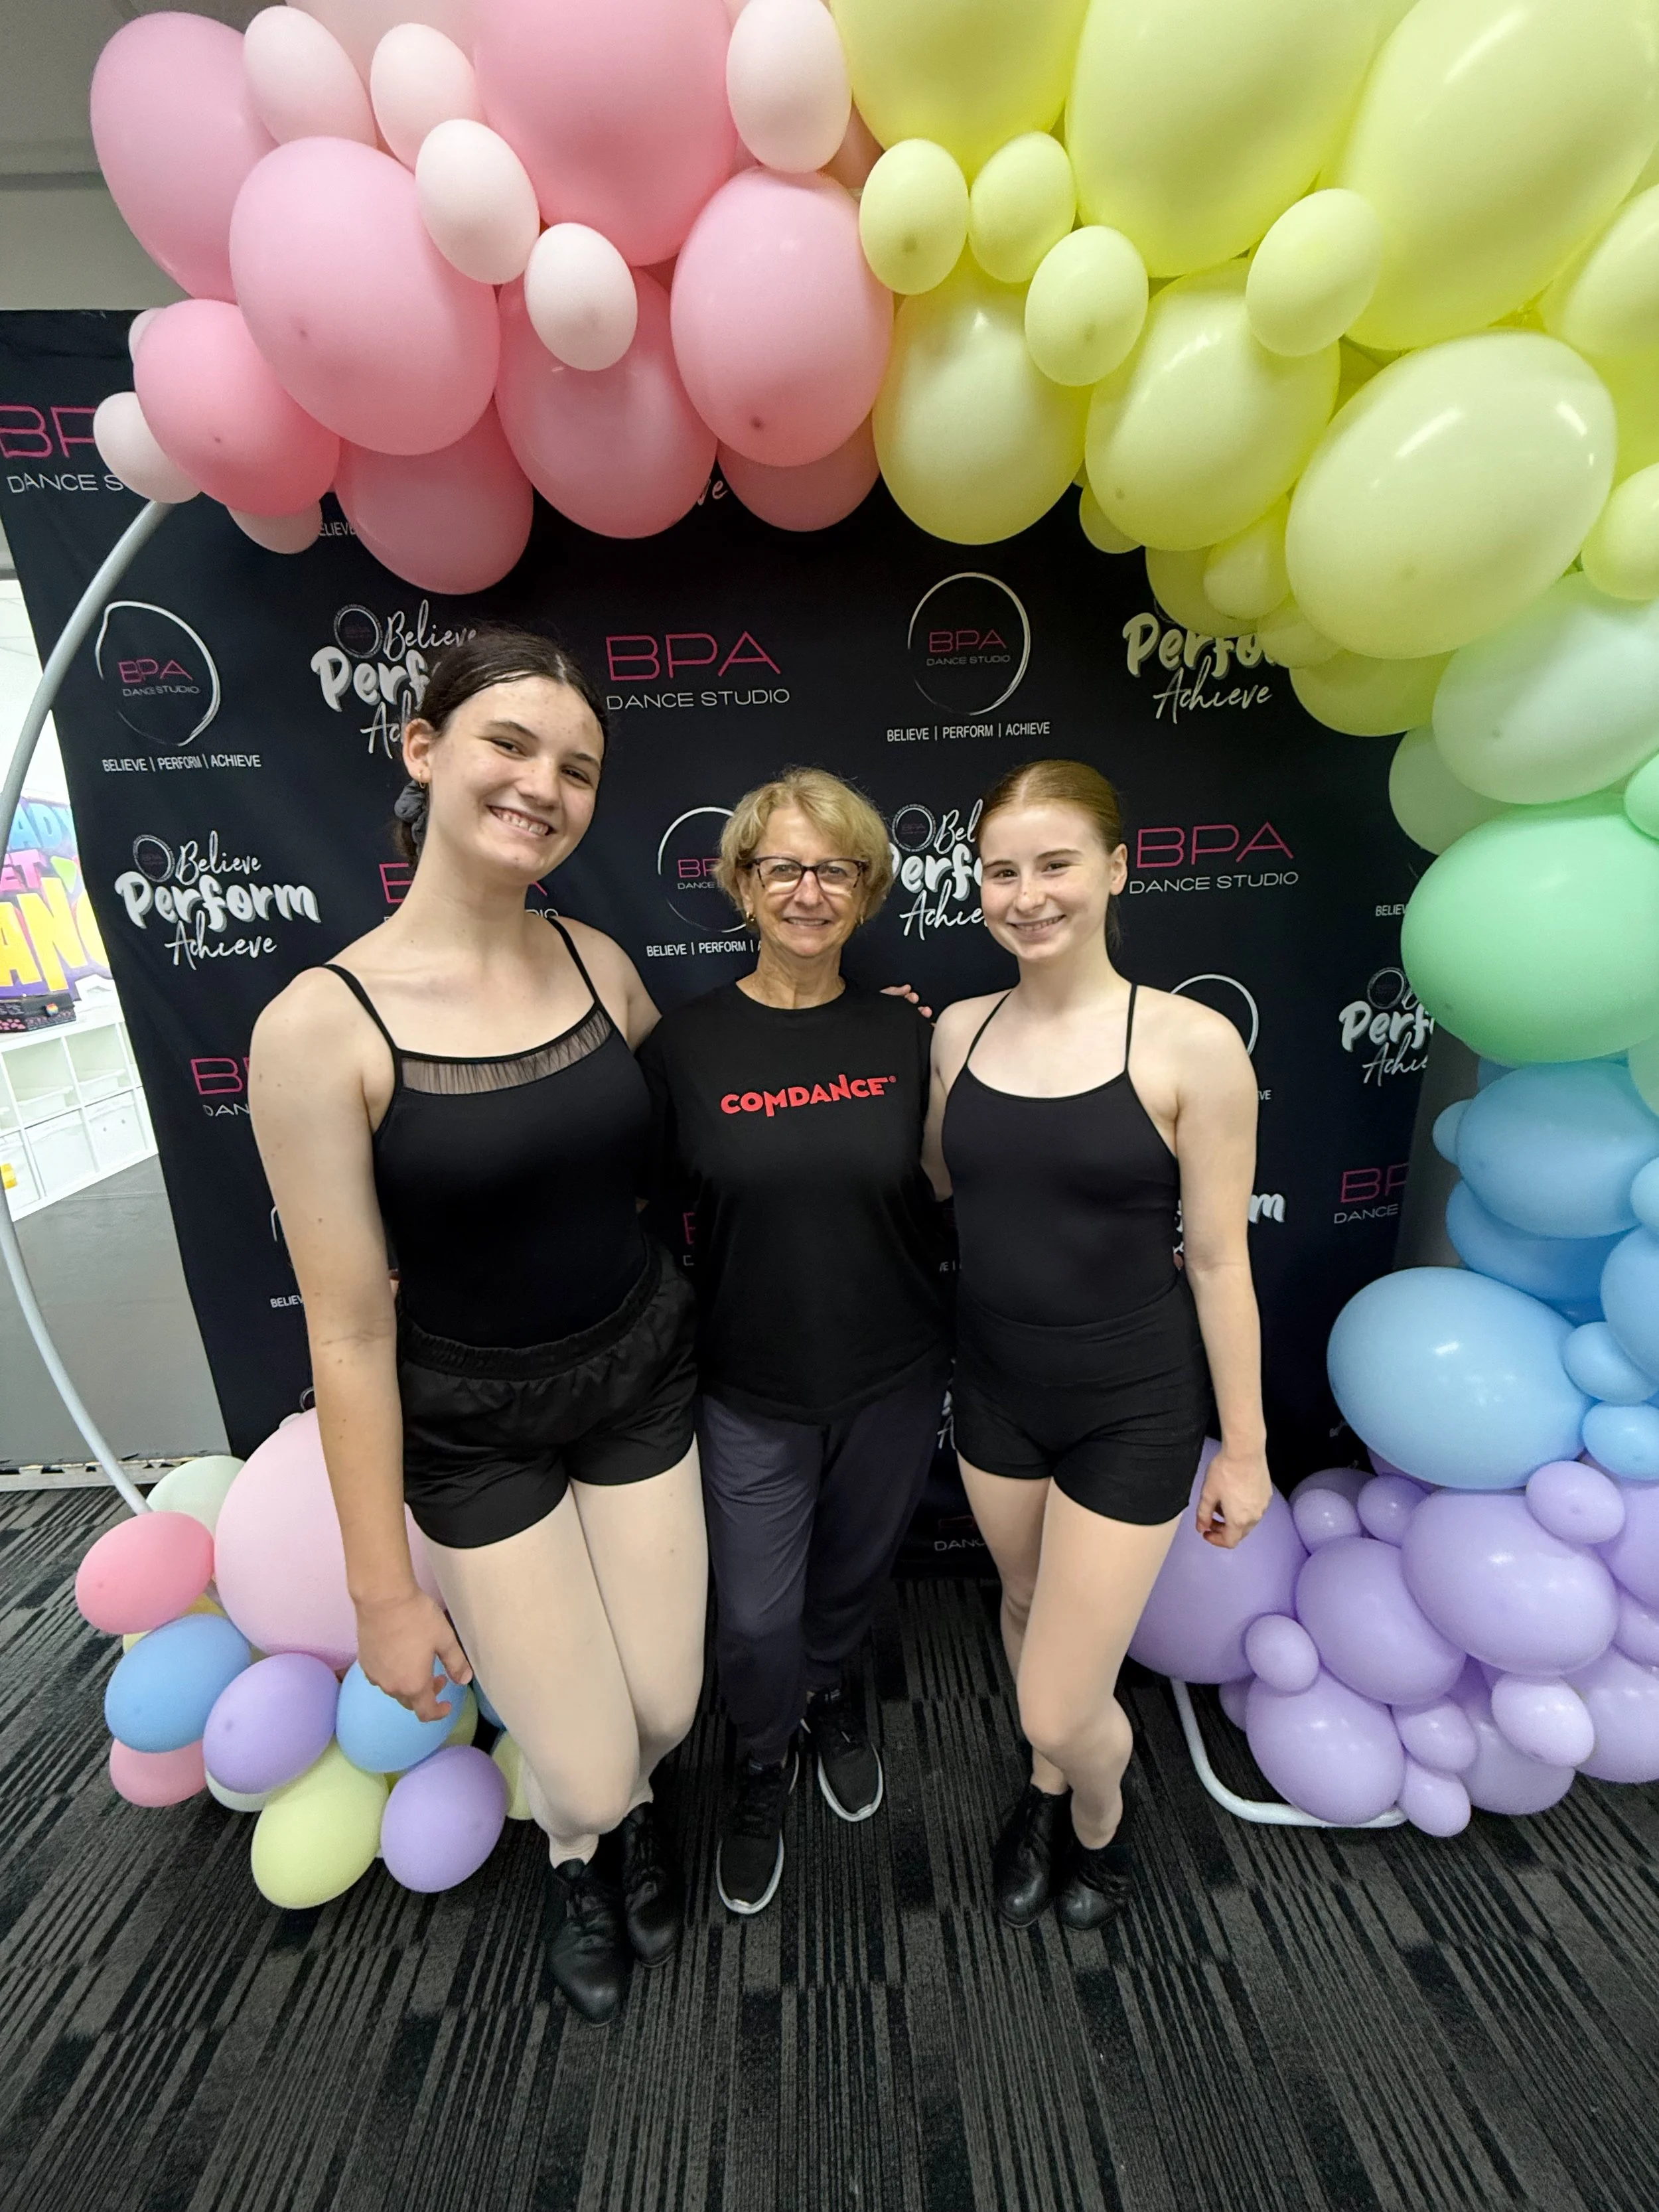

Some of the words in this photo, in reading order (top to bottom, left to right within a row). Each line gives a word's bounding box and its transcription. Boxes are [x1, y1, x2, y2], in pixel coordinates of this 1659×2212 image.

[0, 404, 97, 458] BP
[6, 473, 99, 493] DANCE
[929, 629, 1007, 653] BPA
[606, 631, 781, 681] BPA
[926, 657, 967, 666] DANCE
[969, 654, 1011, 664] STUDIO
[117, 659, 194, 684] BPA
[311, 646, 430, 712] Perf
[122, 688, 156, 698] DANCE
[157, 685, 200, 694] STUDIO
[607, 692, 694, 710] DANCE
[701, 688, 790, 706] STUDIO
[1153, 655, 1272, 724] Achieve
[887, 728, 929, 742] BELIEVE
[942, 724, 993, 739] PERFORM
[1005, 721, 1050, 736] ACHIEVE
[102, 759, 148, 773] BELIEVE
[157, 755, 202, 771] PERFORM
[211, 754, 262, 768] ACHIEVE
[1137, 822, 1293, 869] BPA
[175, 830, 261, 885] Believe
[678, 857, 720, 879] BP
[677, 881, 715, 890] DANCE
[1129, 877, 1210, 894] DANCE
[1216, 871, 1299, 889] STUDIO
[114, 871, 322, 932] Perform
[164, 910, 277, 970] Achieve
[646, 943, 687, 957] BELIEVE
[698, 941, 747, 954] PERFORM
[202, 1103, 250, 1117] DAN
[1340, 1163, 1409, 1203] BP
[1334, 1204, 1399, 1224] DANCE
